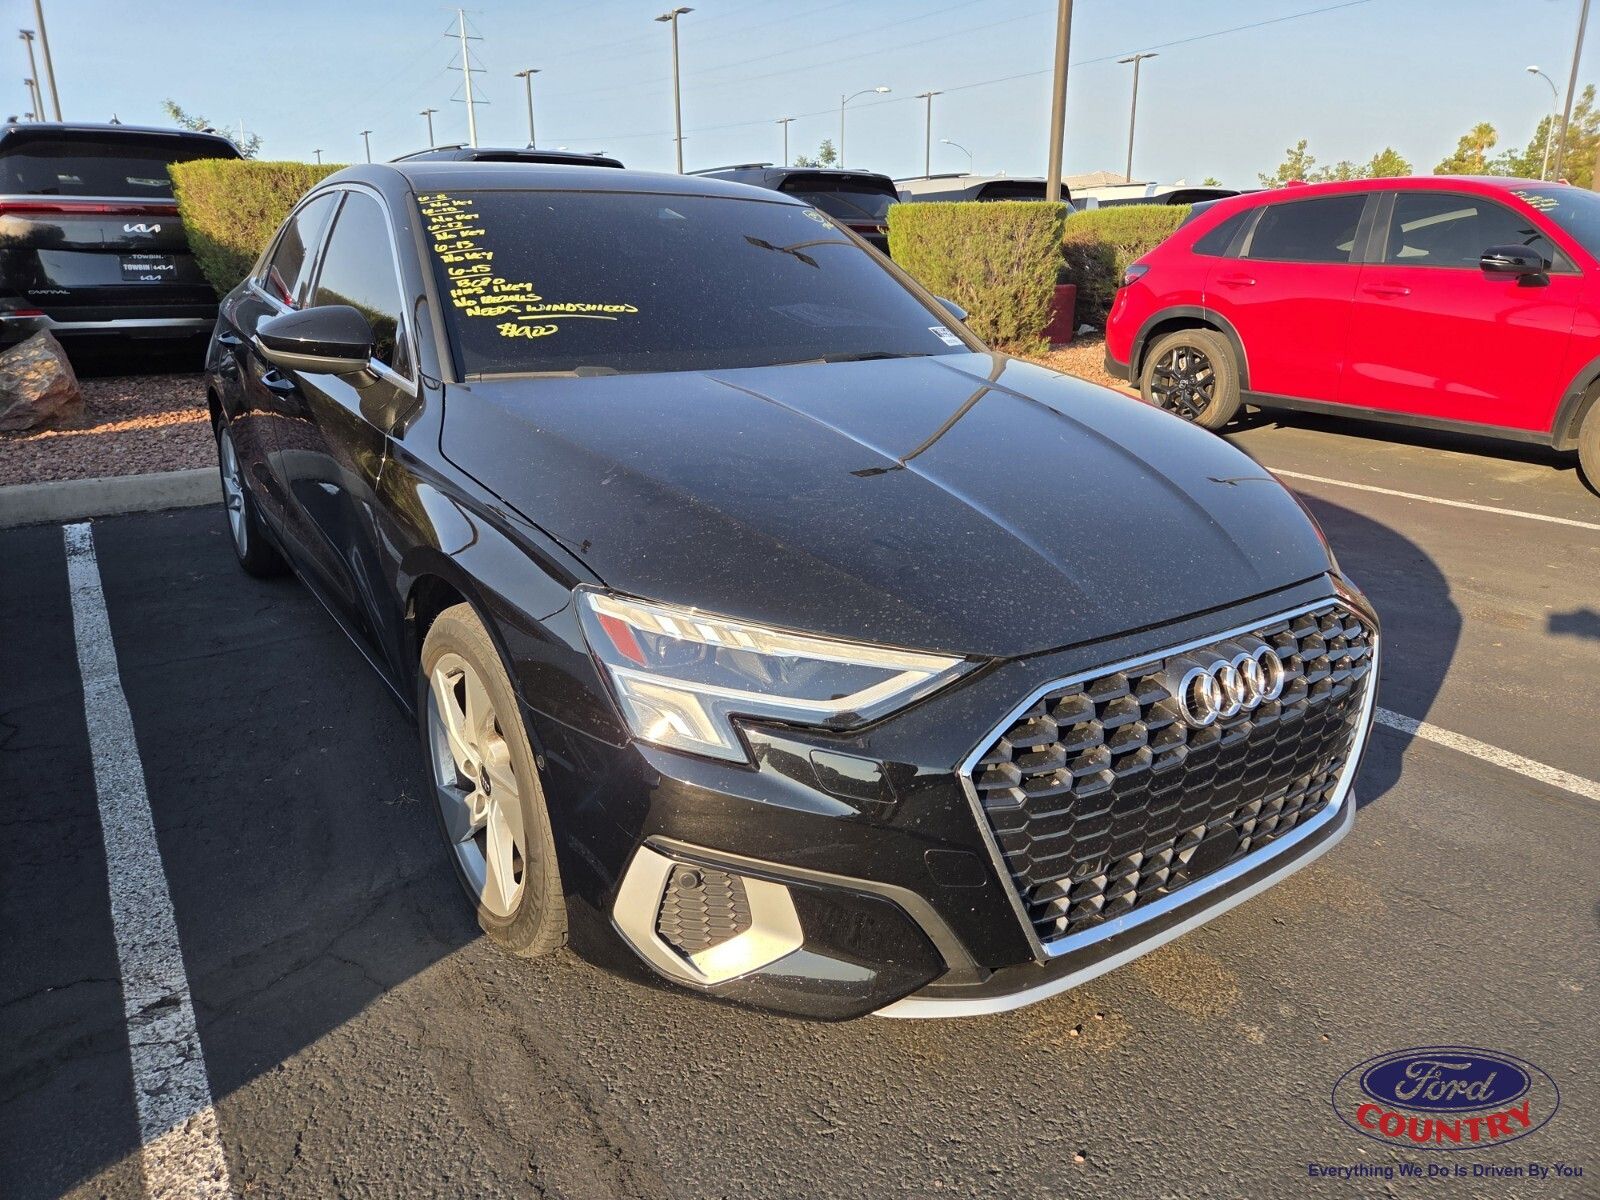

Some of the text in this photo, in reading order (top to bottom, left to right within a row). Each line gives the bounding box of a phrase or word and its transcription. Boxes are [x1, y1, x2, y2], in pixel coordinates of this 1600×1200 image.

[123, 223, 161, 233] KIA
[465, 302, 639, 317] NEEDS WINDSHIELD
